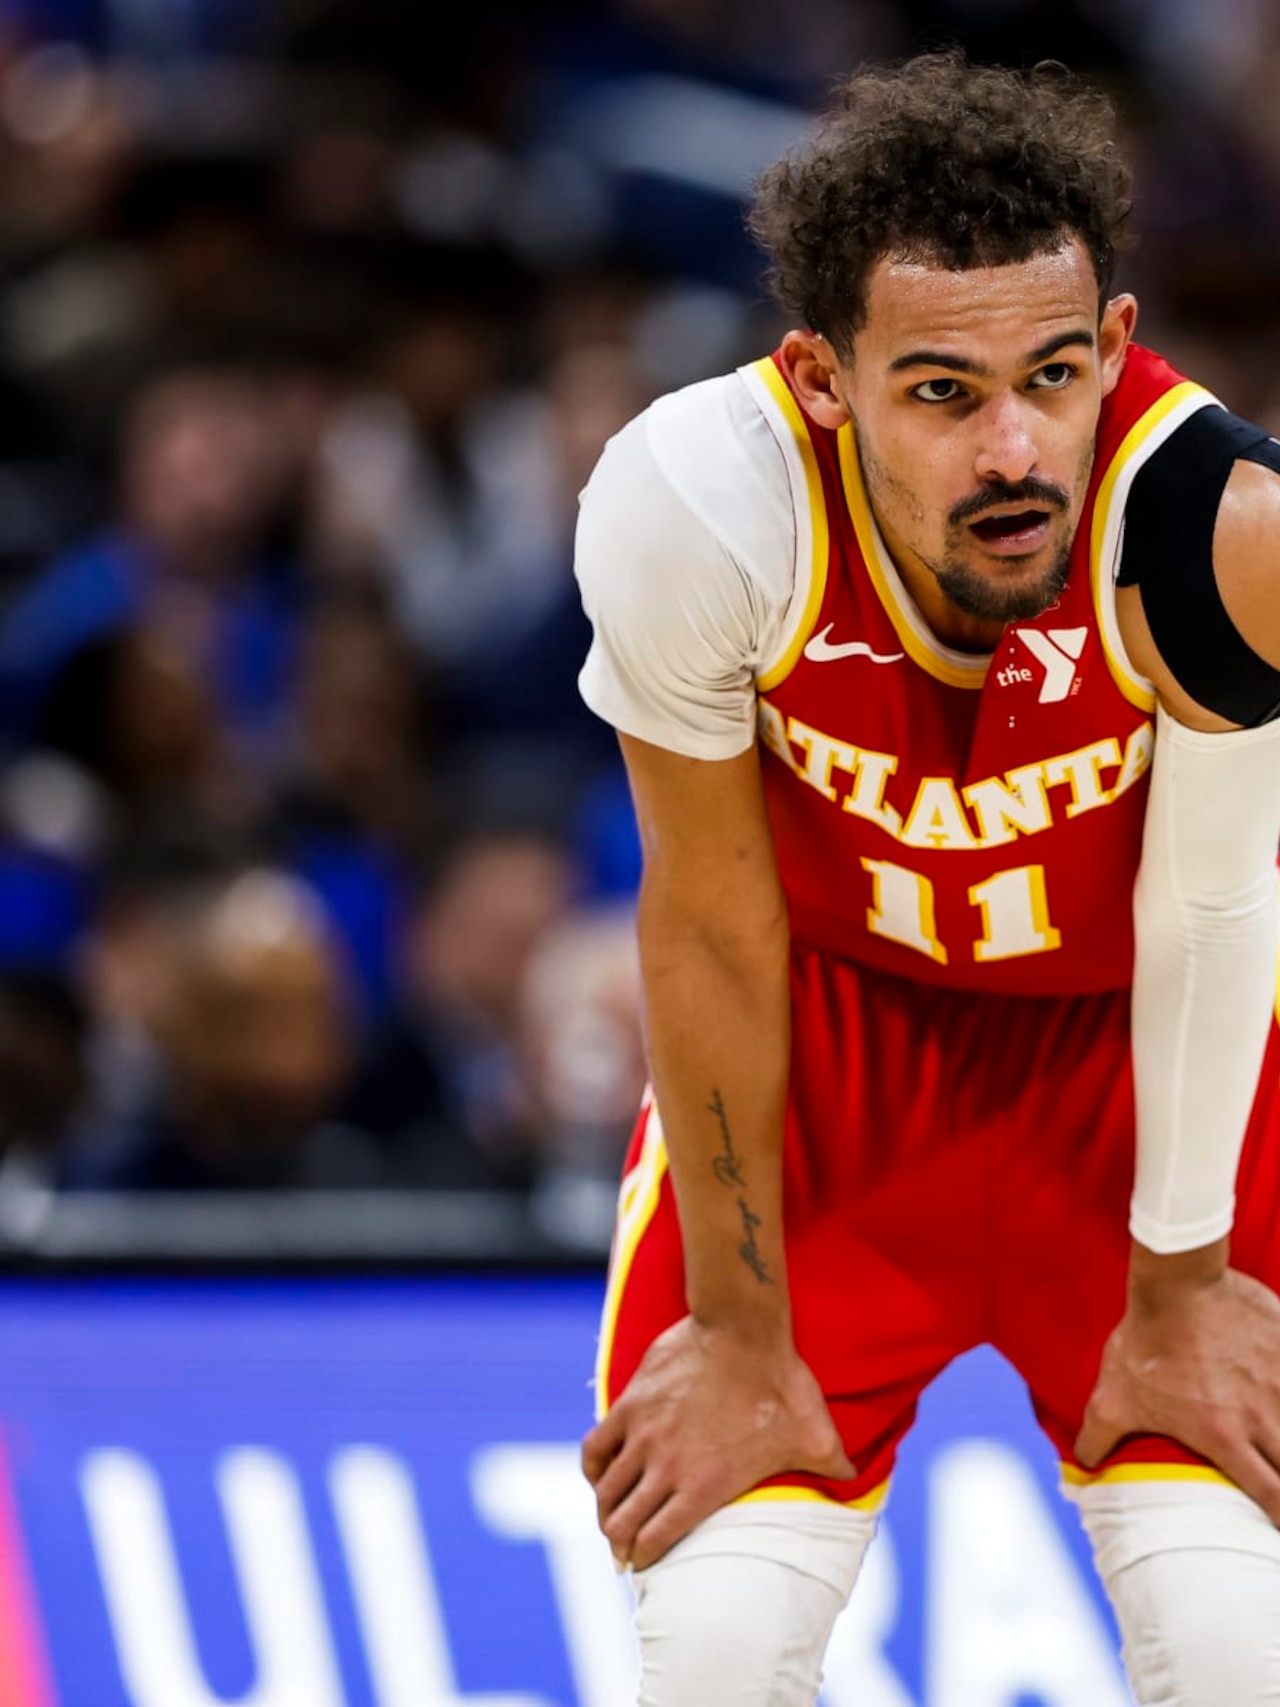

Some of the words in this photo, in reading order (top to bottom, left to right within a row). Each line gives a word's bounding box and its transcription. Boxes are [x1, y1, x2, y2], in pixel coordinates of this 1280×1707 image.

[996, 666, 1034, 687] the
[758, 696, 1156, 850] ATLANTA
[859, 856, 1062, 966] 11
[80, 1440, 1138, 1707] ULTA
